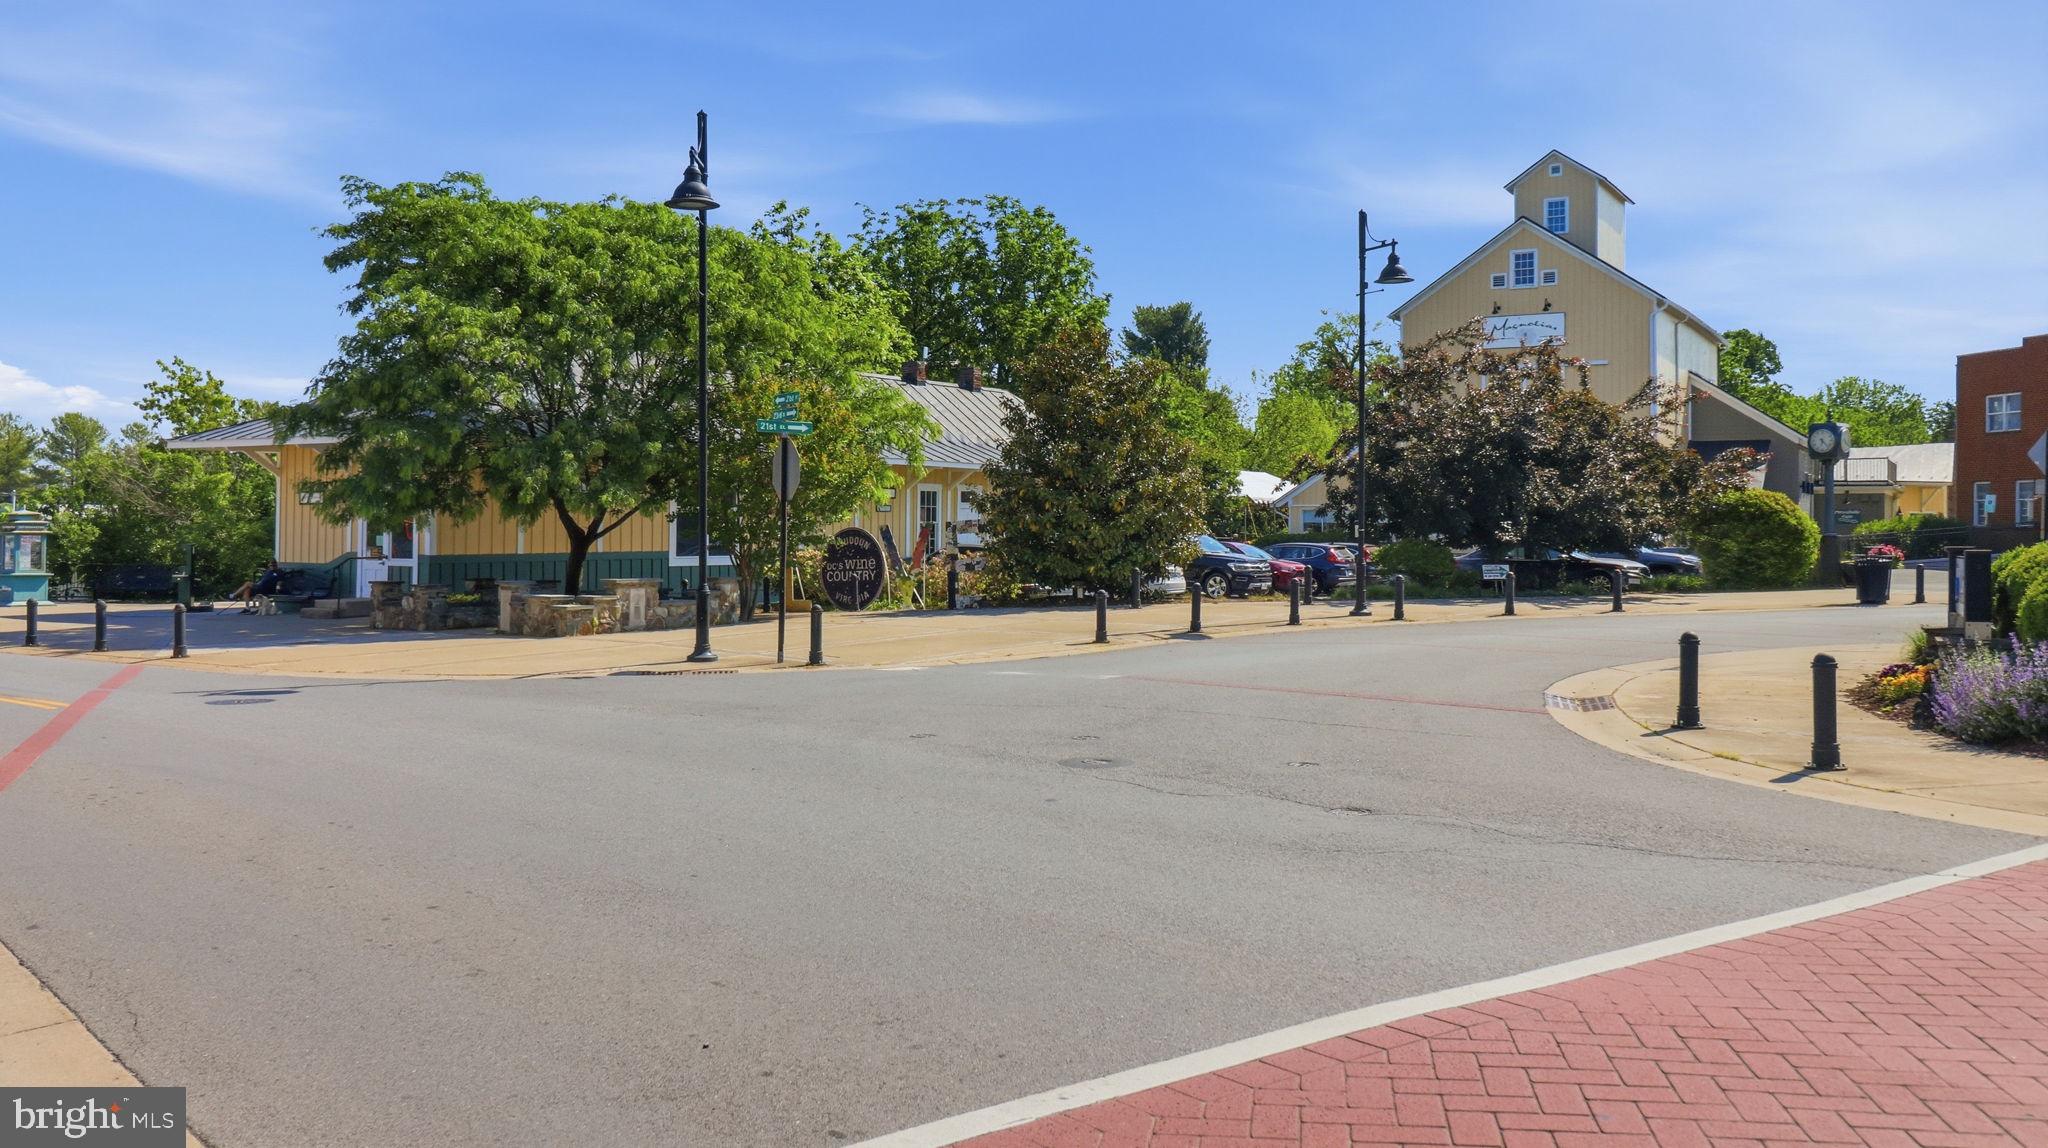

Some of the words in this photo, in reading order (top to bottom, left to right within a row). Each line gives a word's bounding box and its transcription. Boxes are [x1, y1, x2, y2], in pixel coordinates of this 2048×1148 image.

[760, 422, 777, 430] 21st
[835, 536, 871, 550] LUDOUN
[836, 591, 870, 605] VIRGIA
